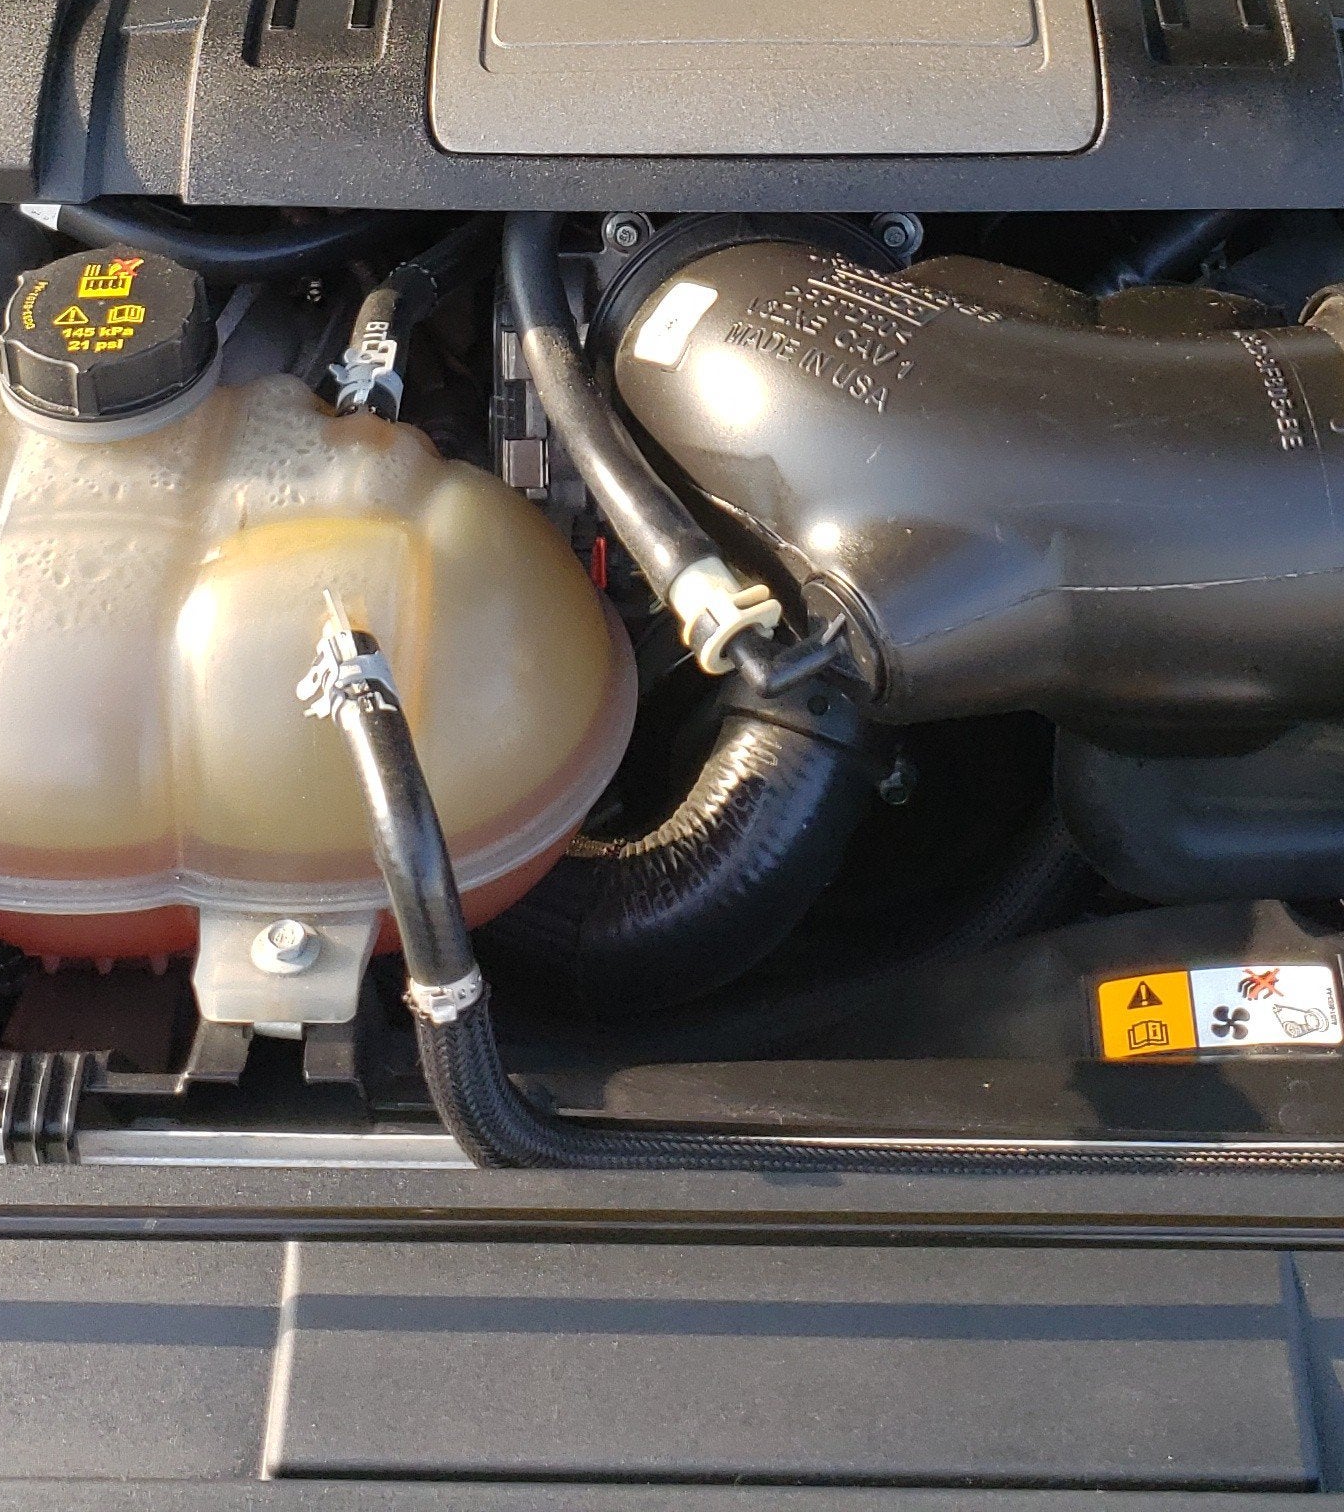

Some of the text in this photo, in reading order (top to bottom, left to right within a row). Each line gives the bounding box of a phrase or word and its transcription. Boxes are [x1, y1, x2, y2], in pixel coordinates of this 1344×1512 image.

[62, 326, 134, 339] 145 kPa
[67, 338, 124, 353] 21 psi
[723, 321, 891, 415] MADE IN USA
